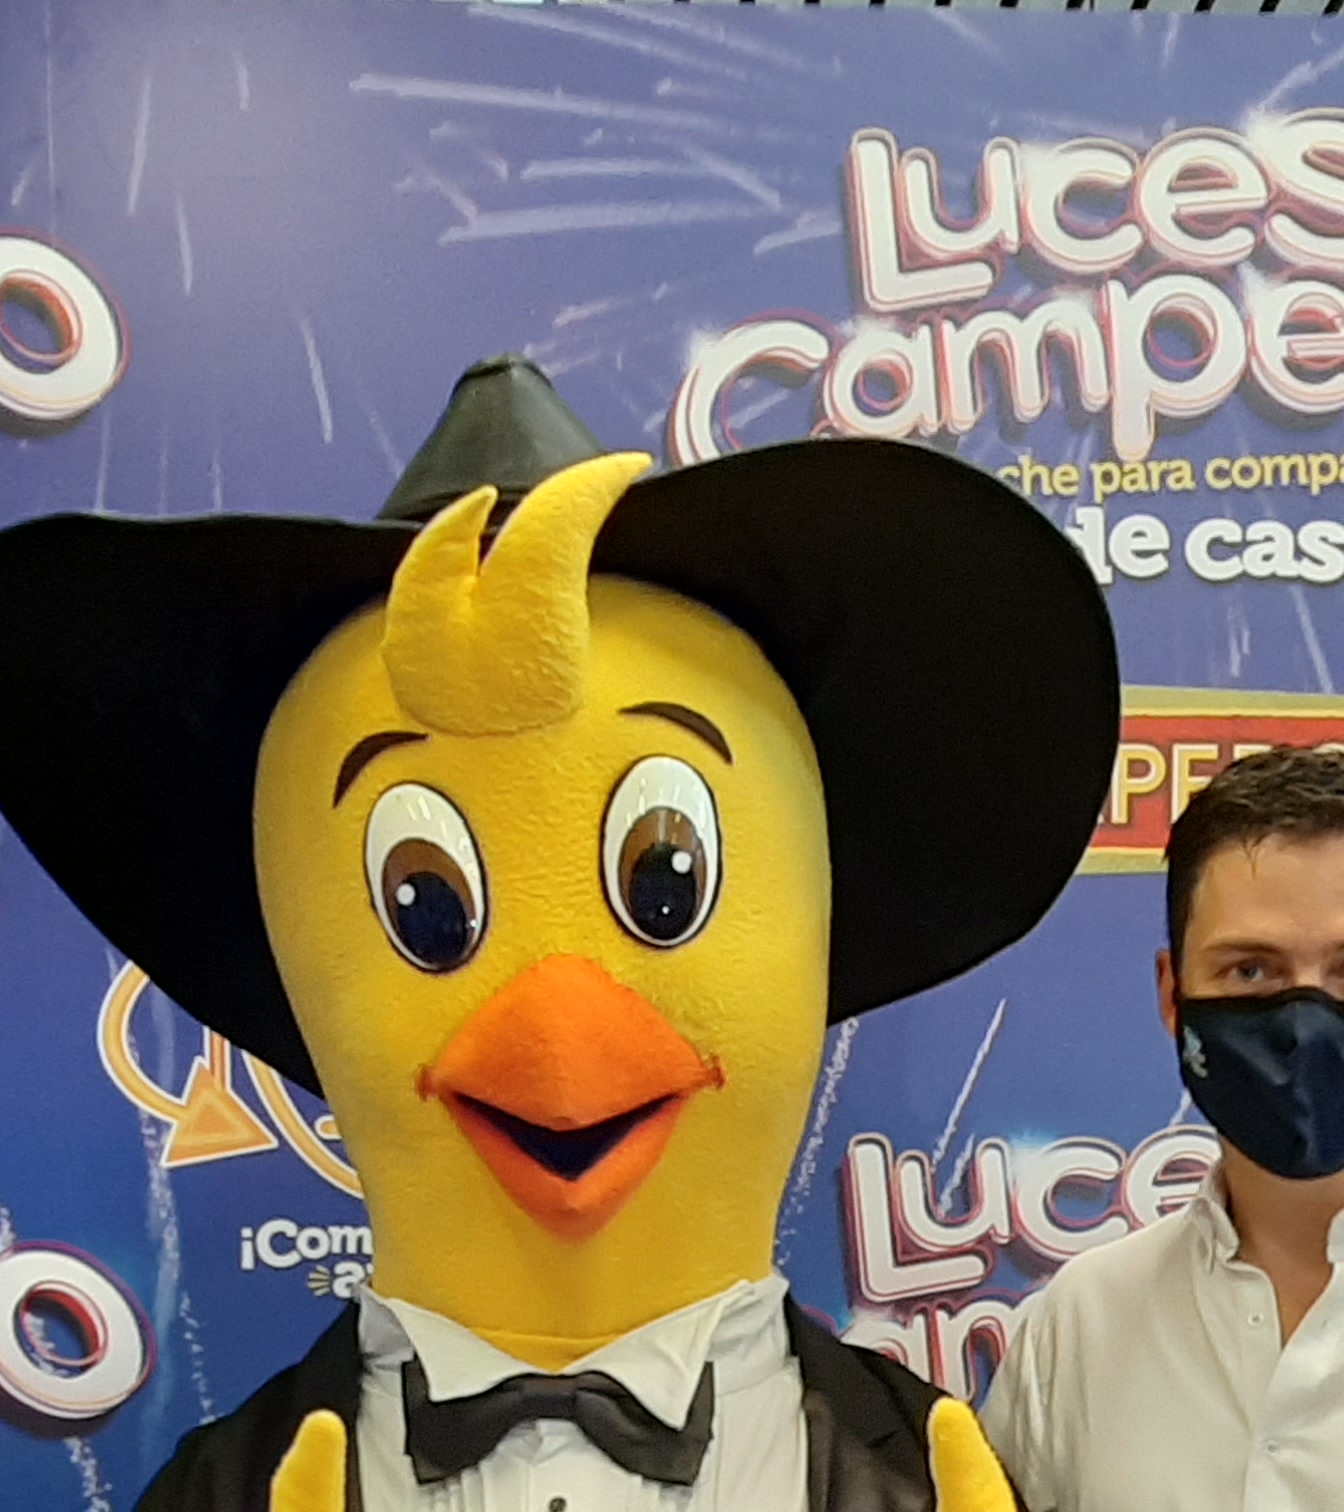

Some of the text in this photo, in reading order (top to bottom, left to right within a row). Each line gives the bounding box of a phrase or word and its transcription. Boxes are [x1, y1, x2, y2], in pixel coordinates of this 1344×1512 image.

[1091, 457, 1195, 503] para
[840, 1124, 1223, 1303] Luce
[241, 1219, 374, 1270] ¡Com
